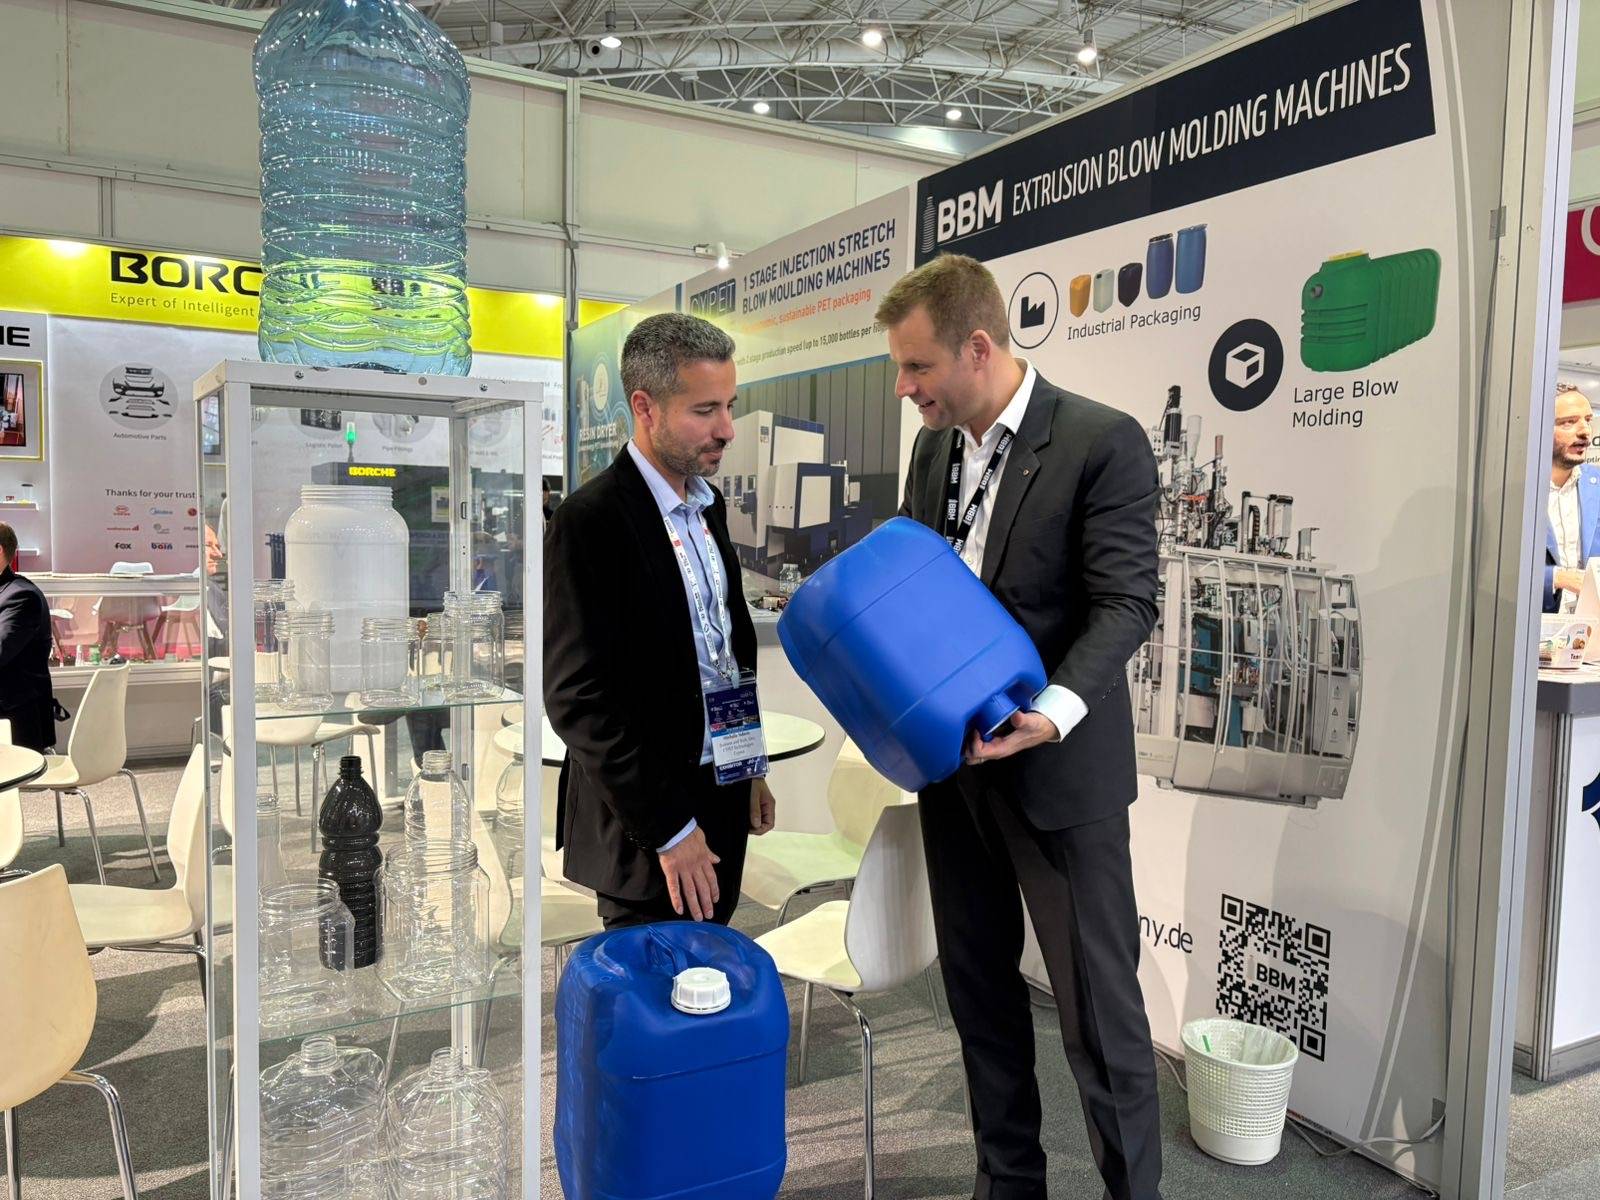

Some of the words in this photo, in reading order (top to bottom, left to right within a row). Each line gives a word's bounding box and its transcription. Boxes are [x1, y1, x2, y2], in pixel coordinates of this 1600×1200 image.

[937, 179, 1004, 243] BBM
[1012, 153, 1103, 217] EXTRUSION
[1107, 131, 1165, 185] BLOW
[1168, 93, 1268, 166] MOLDING
[1273, 42, 1412, 131] MACHINES
[743, 275, 748, 292] 1
[750, 262, 777, 290] STAGE
[779, 241, 836, 278] INJECTION
[838, 218, 896, 257] STRETCH
[742, 291, 768, 314] BLOW
[769, 271, 823, 306] MOULDING
[826, 247, 891, 288] MACHINES
[111, 292, 157, 307] Expert
[163, 298, 177, 309] of
[183, 299, 255, 317] Intelligent
[779, 303, 816, 323] sustainable
[817, 296, 832, 313] PET
[832, 288, 872, 311] packaging
[1067, 315, 1126, 340] Industrial
[1130, 305, 1201, 329] Packaging
[786, 342, 803, 358] speed
[812, 337, 819, 348] to
[819, 331, 839, 347] 15,000
[839, 328, 860, 342] bottles
[860, 325, 872, 338] per
[1294, 385, 1345, 405] Large
[1352, 379, 1399, 398] Blow
[1292, 407, 1364, 428] Molding
[113, 432, 150, 441] Automotive
[596, 423, 617, 439] DRYER
[998, 434, 1012, 450] BBM
[348, 466, 397, 477] BORCHE
[950, 467, 960, 484] BBM
[982, 469, 993, 486] BBM
[105, 489, 138, 497] Thanks
[139, 490, 152, 498] for
[154, 491, 174, 499] your
[176, 491, 196, 499] trust
[948, 503, 957, 520] BBM
[966, 504, 978, 521] BBM
[1256, 962, 1296, 995] BBM
